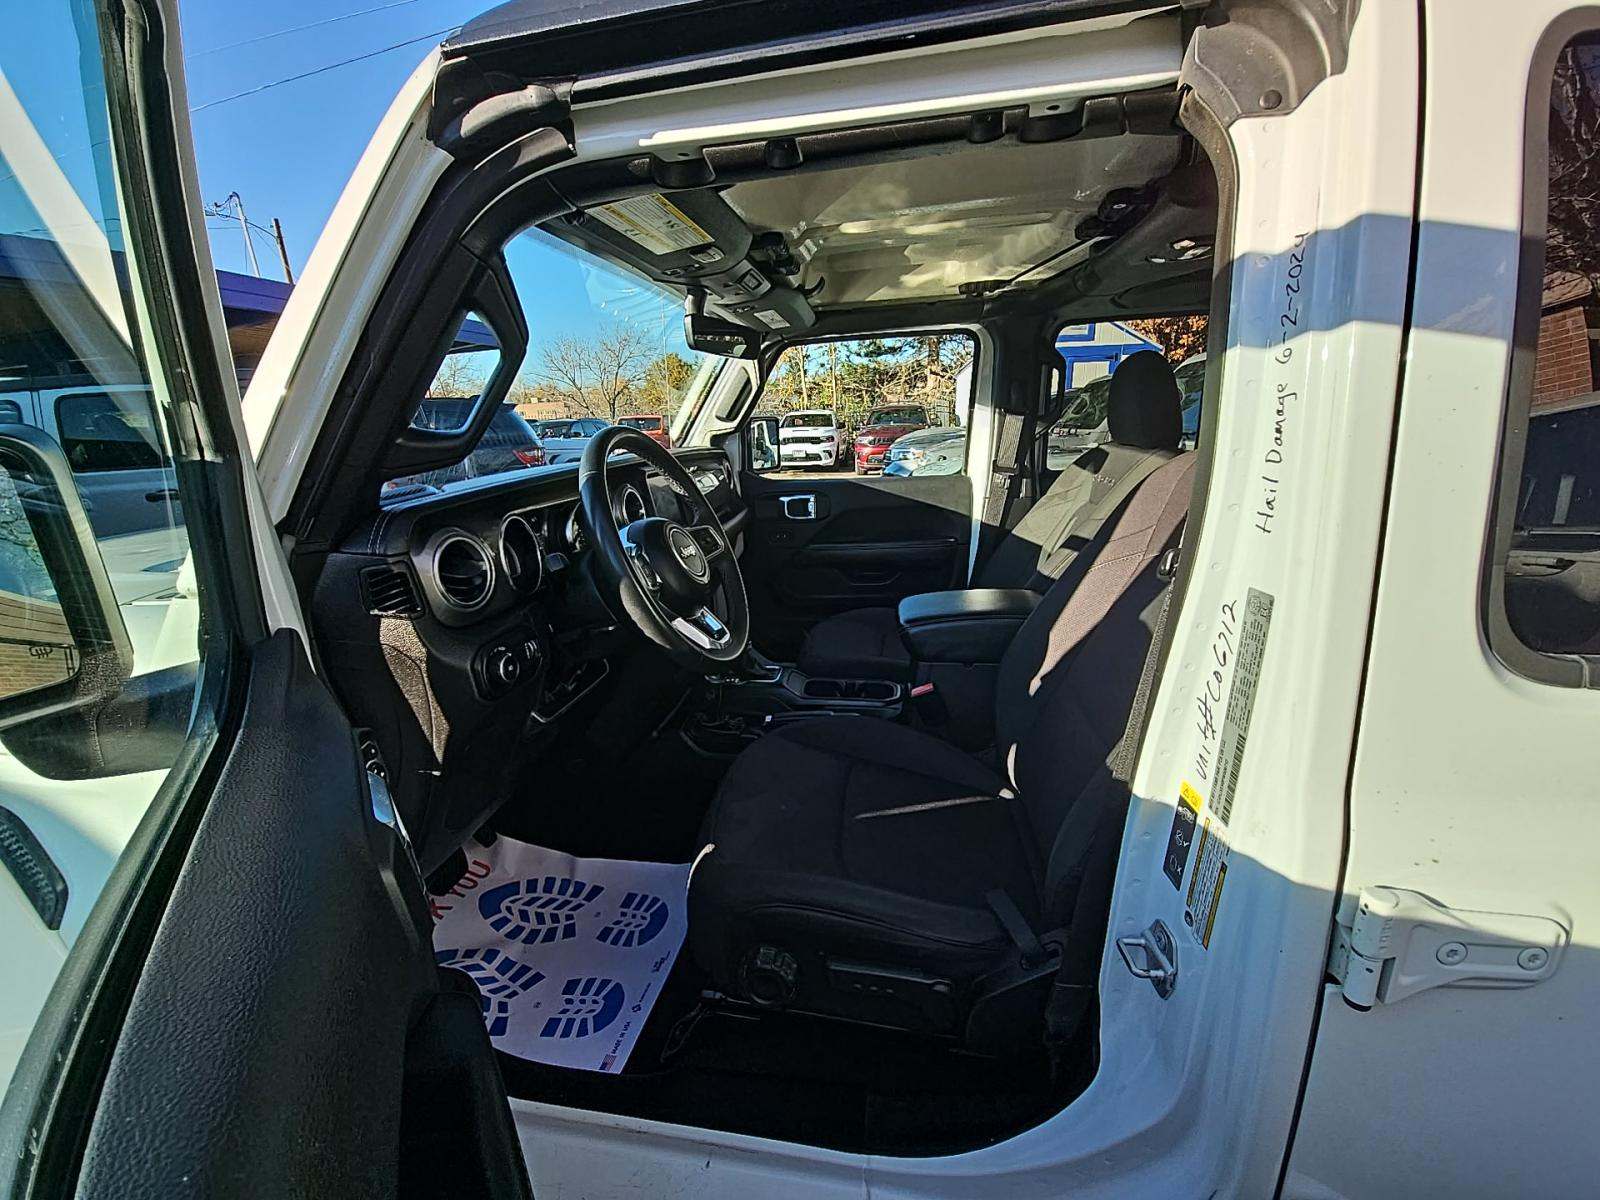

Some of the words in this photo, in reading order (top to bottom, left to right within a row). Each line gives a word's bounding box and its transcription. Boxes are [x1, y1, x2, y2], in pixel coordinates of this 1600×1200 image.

[1275, 231, 1308, 365] 6-2-2024
[1265, 382, 1298, 464] Damage
[1255, 475, 1279, 534] Hail
